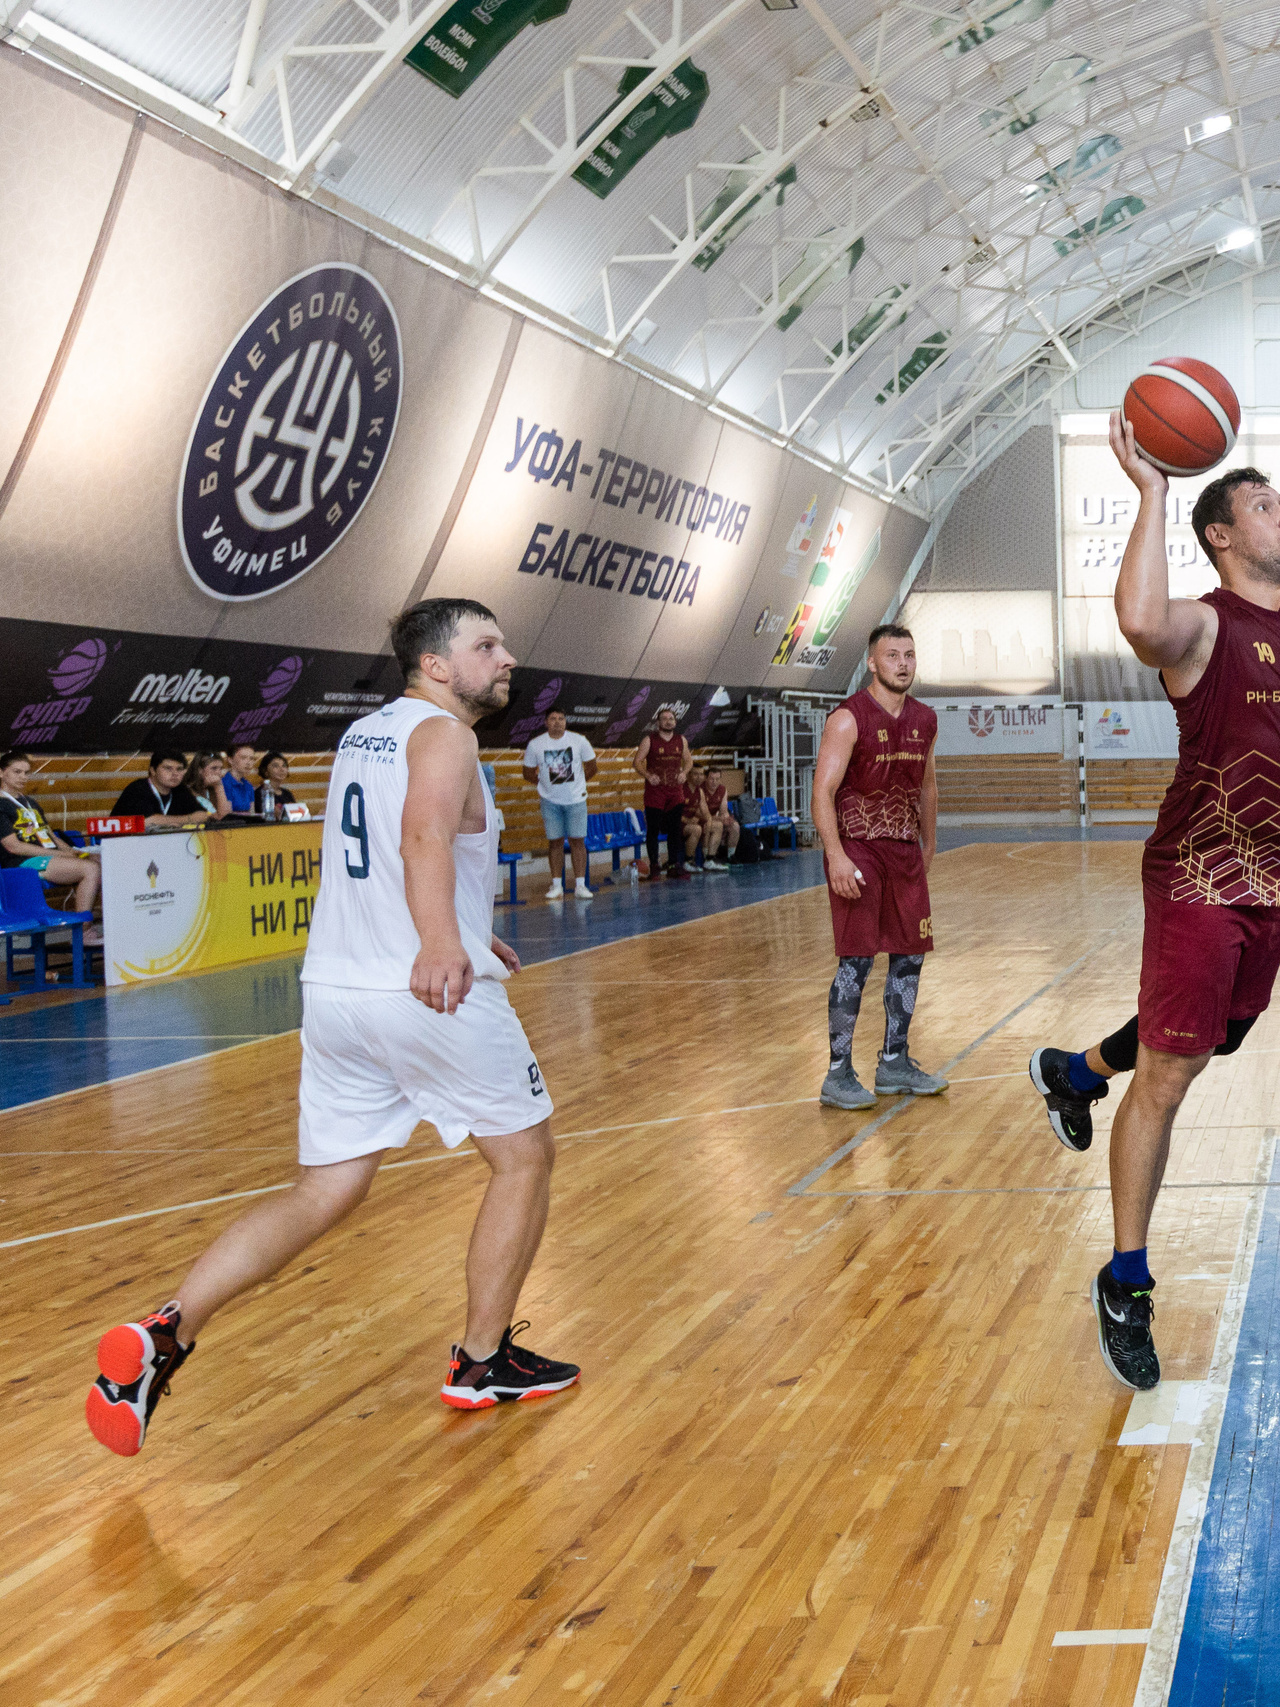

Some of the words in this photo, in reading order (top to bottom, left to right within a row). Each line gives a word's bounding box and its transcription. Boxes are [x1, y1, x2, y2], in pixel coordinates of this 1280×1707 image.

[424, 35, 469, 73] ВОЛЕЙБОЛ
[448, 23, 477, 49] МСМК
[663, 73, 692, 101] ОЛЬВИЧ
[586, 152, 615, 178] ОЛЕЙБОЛ
[198, 291, 393, 498] БАСКЕТБОЛЬНЫЙ
[325, 416, 385, 527] КЛУБ
[504, 416, 752, 546] УФА-ТЕРРИТОРИЯ
[202, 514, 308, 577] УФИМЕЦ
[517, 521, 702, 607] БАСКЕТБОЛА
[1253, 641, 1276, 664] 19
[129, 668, 231, 704] molten
[10, 695, 94, 730] СУПЕР
[228, 703, 289, 733] СУПЕР
[1001, 706, 1047, 726] ULTRA
[11, 725, 60, 746] ЛИГА
[877, 729, 888, 742] 93
[341, 782, 370, 880] 9
[248, 852, 284, 888] НИ
[290, 847, 323, 889] ДН
[251, 900, 287, 937] НИ
[919, 915, 932, 939] 93
[527, 1061, 544, 1097] 9
